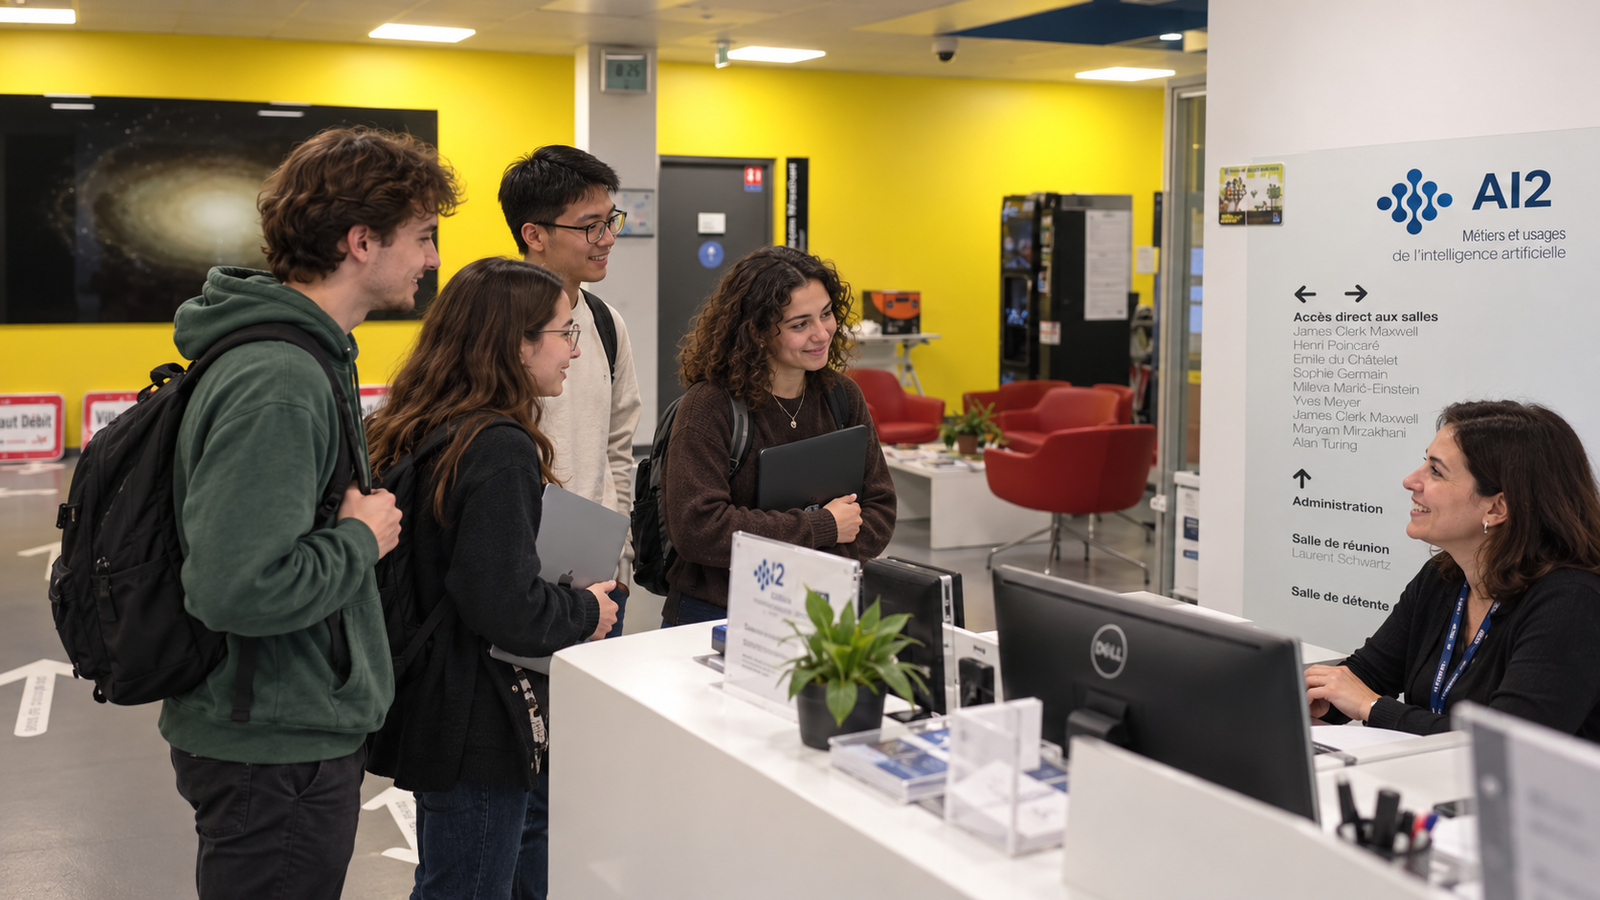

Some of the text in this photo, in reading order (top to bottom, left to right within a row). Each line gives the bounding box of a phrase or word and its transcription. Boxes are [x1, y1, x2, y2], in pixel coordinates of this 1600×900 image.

[1471, 169, 1552, 210] AI2
[1462, 228, 1567, 243] Métiers et usages
[1392, 246, 1567, 264] de l'intelligence artificielle
[1293, 311, 1439, 322] Accès direct aux salles
[1293, 326, 1419, 337] James Clerk Maxwell
[1293, 340, 1380, 351] Henri Poincaré
[1293, 353, 1398, 366] Emile du Châtelet
[1293, 367, 1388, 380] Sophie Germain
[1293, 381, 1420, 395] Mileva Marić-Einstein
[1293, 395, 1361, 410] Yves Meyer
[1293, 410, 1419, 424] James Clerk Maxwell
[1292, 423, 1407, 438] Maryam Mirzakhani
[1292, 437, 1358, 453] Alan Turing
[1292, 496, 1383, 514] Administration
[1292, 533, 1390, 555] Salle de réunion
[1292, 547, 1391, 571] Laurent Schwartz
[1291, 586, 1390, 612] Salle de détente
